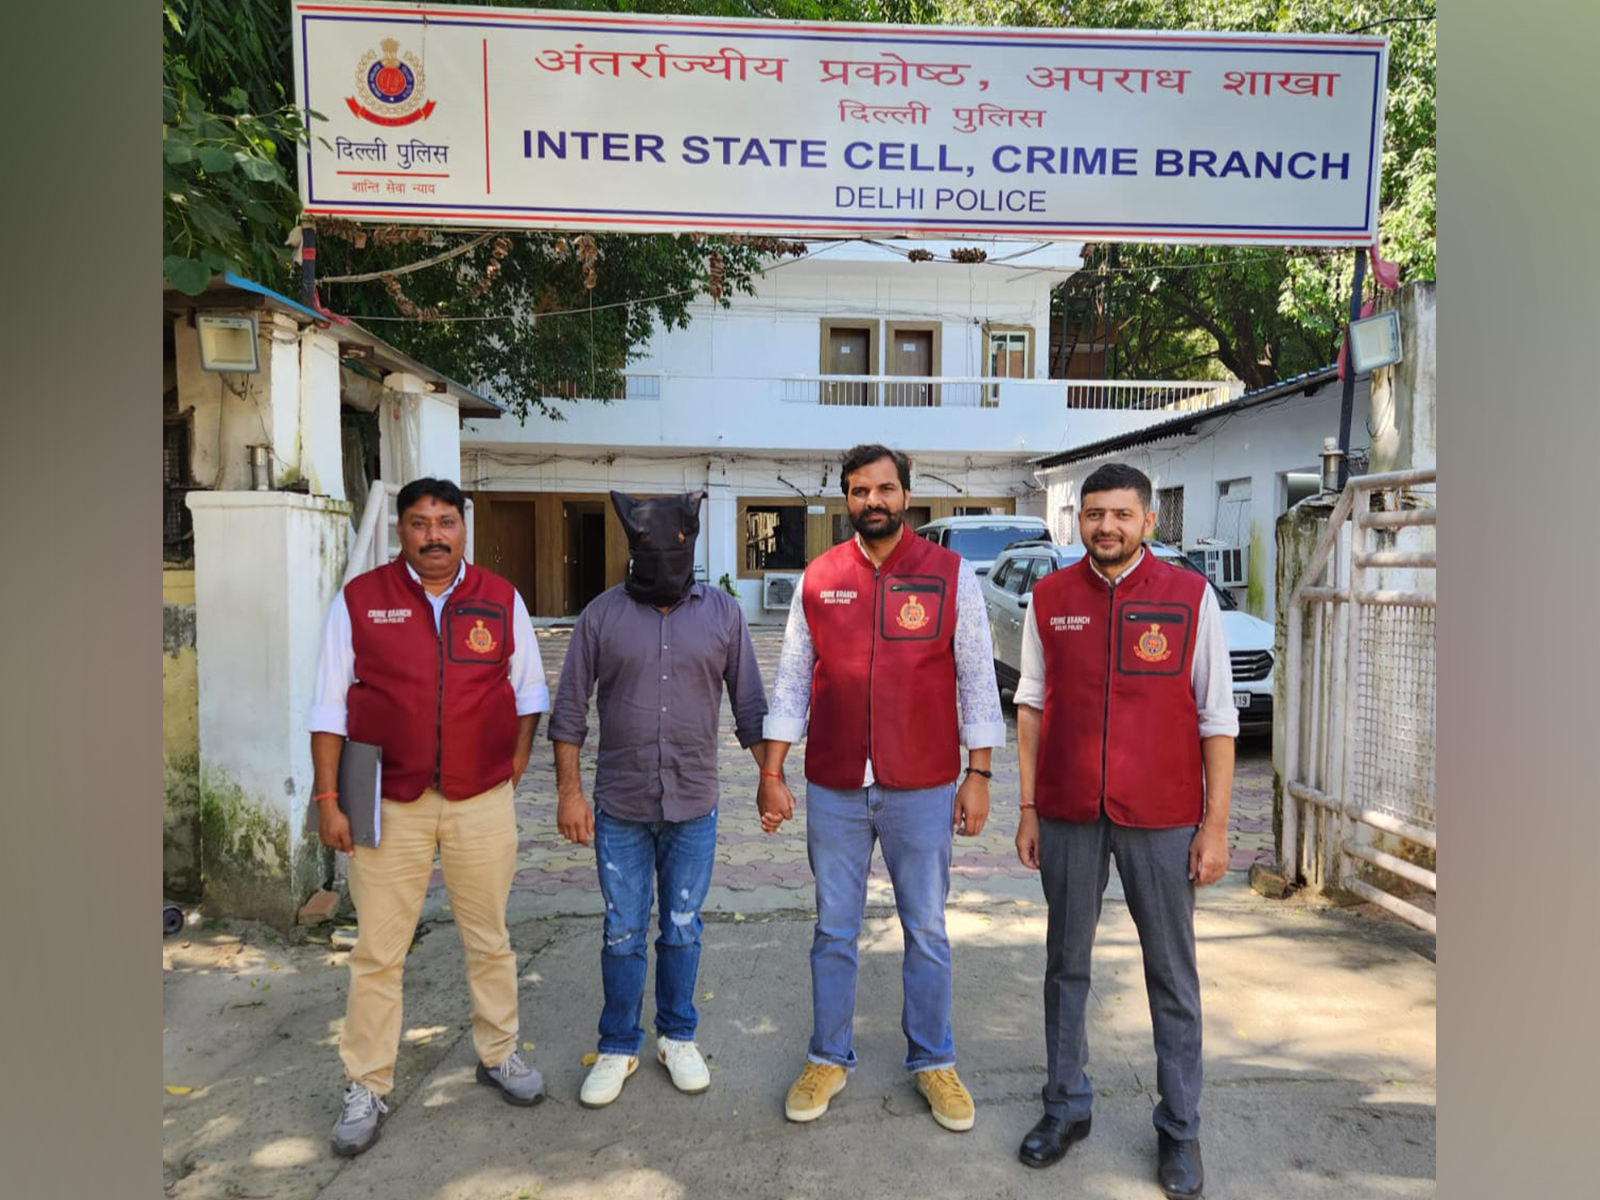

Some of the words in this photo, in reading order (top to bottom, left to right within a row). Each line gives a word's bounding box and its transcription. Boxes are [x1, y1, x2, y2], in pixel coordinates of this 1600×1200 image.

[533, 43, 790, 82] अंतर्राज्यीय
[1025, 66, 1192, 94] अपराध
[1222, 71, 1341, 98] शाखा
[838, 99, 931, 125] दिल्ली
[952, 102, 1047, 134] पुलिस
[336, 136, 388, 162] दिल्ली
[396, 138, 449, 170] पुलिस
[523, 129, 666, 163] INTER
[681, 135, 828, 169] STATE
[843, 141, 975, 178] CELL,
[991, 144, 1139, 177] CRIME
[1155, 149, 1350, 181] BRANCH
[835, 185, 924, 210] DELHI
[935, 188, 1047, 213] POLICE
